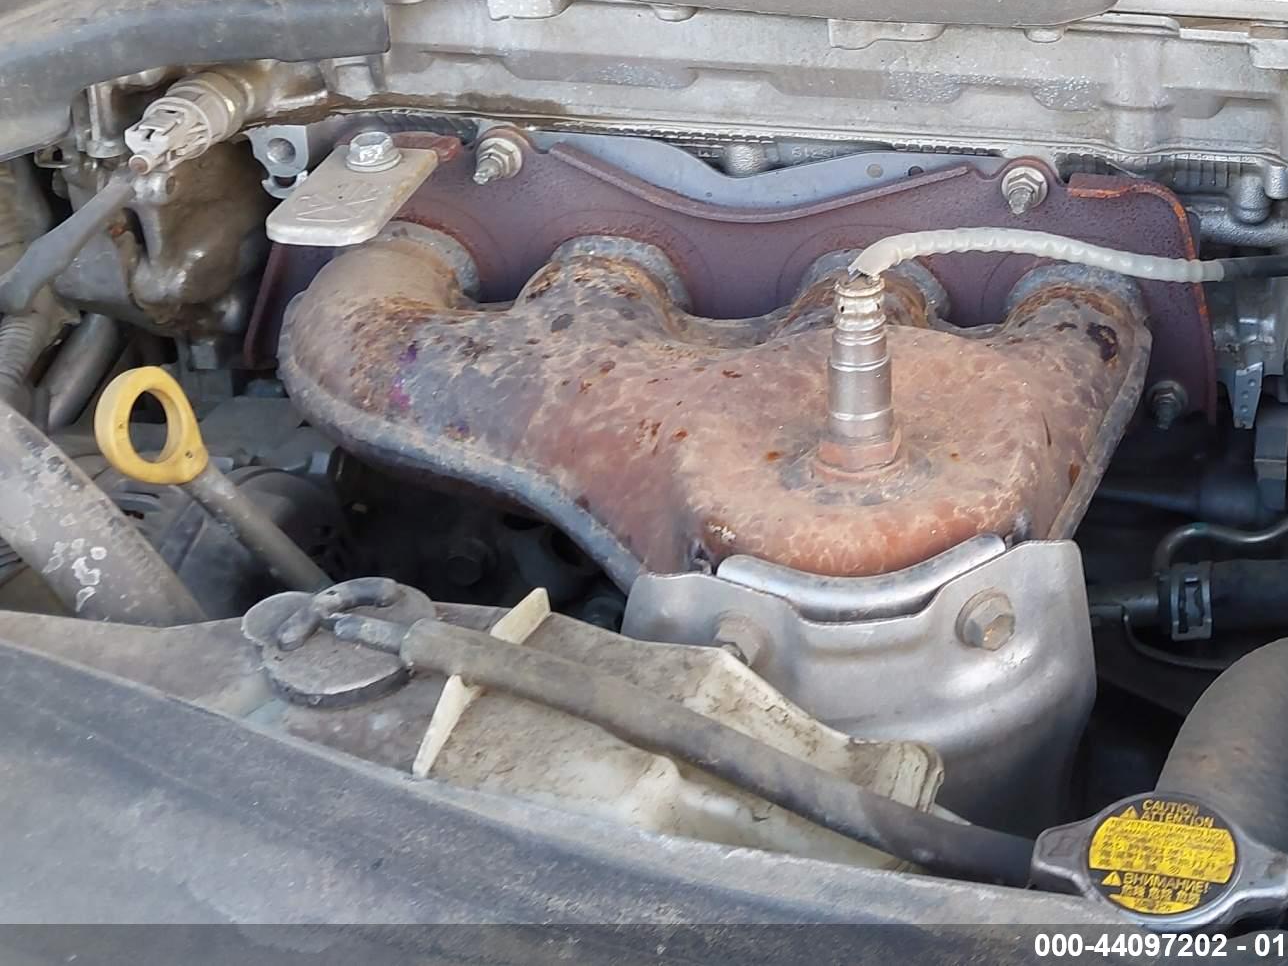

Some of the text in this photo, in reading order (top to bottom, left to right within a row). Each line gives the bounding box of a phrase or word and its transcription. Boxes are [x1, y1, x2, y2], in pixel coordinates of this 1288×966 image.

[1142, 799, 1200, 815] CAUTION
[1140, 811, 1215, 828] ATTENTION
[1122, 872, 1211, 894] ВНИМАНИЕ!
